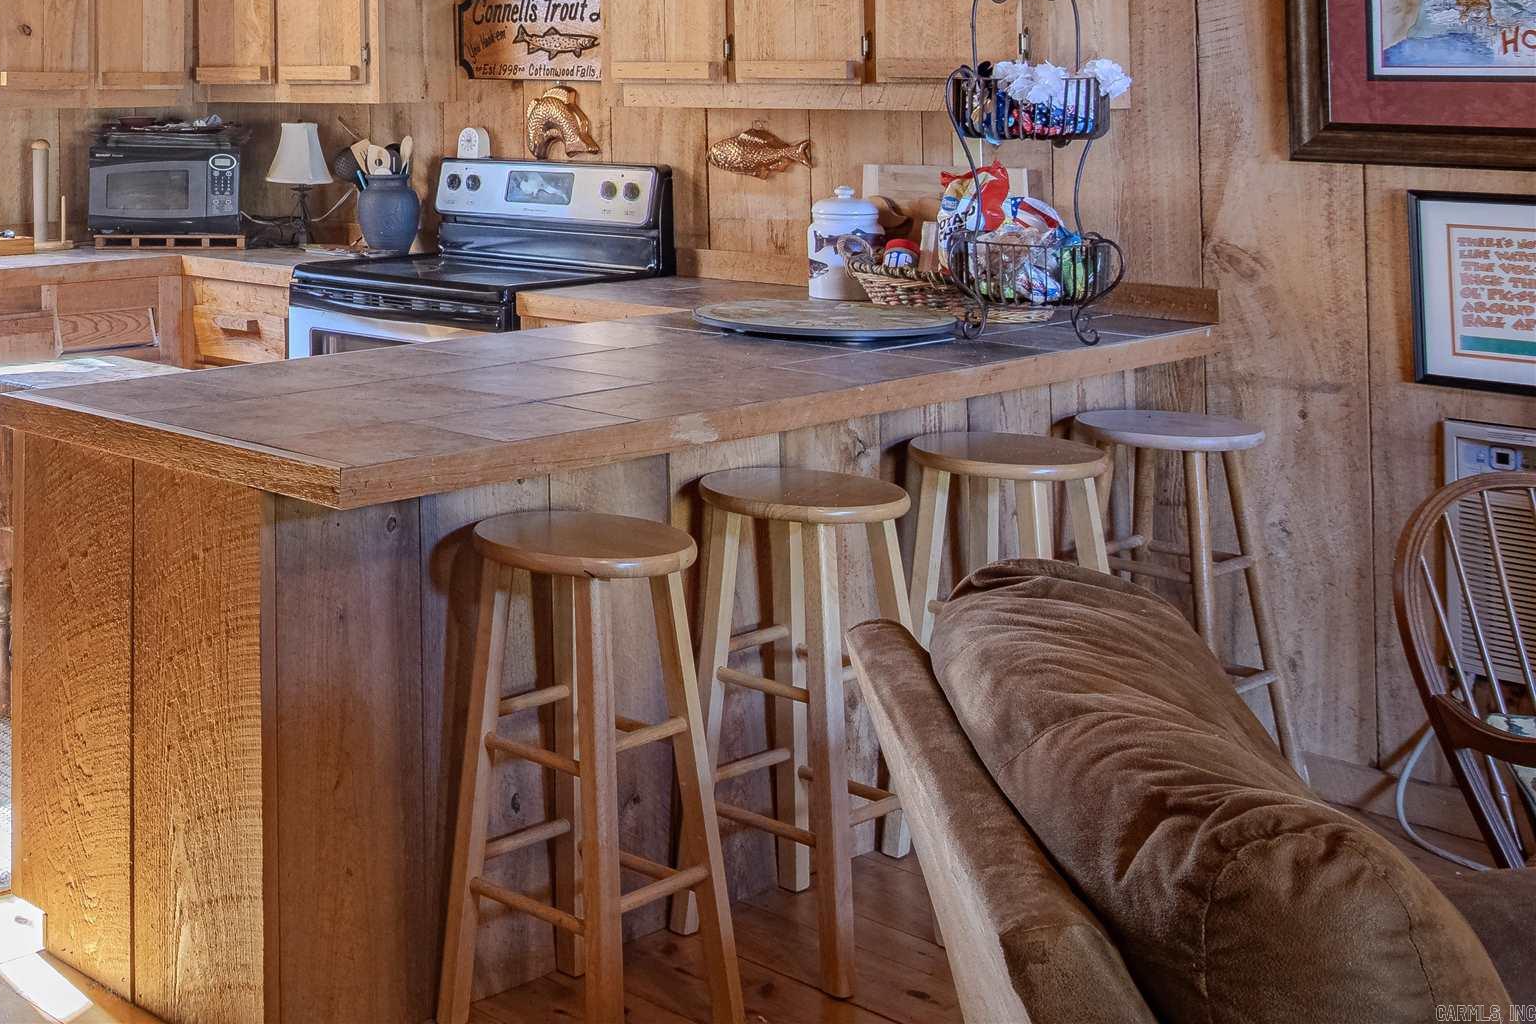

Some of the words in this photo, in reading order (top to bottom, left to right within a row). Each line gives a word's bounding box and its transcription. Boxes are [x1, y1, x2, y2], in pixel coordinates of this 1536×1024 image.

[498, 64, 518, 76] 1998
[528, 63, 575, 77] Cottonwood
[938, 205, 976, 231] OTATO
